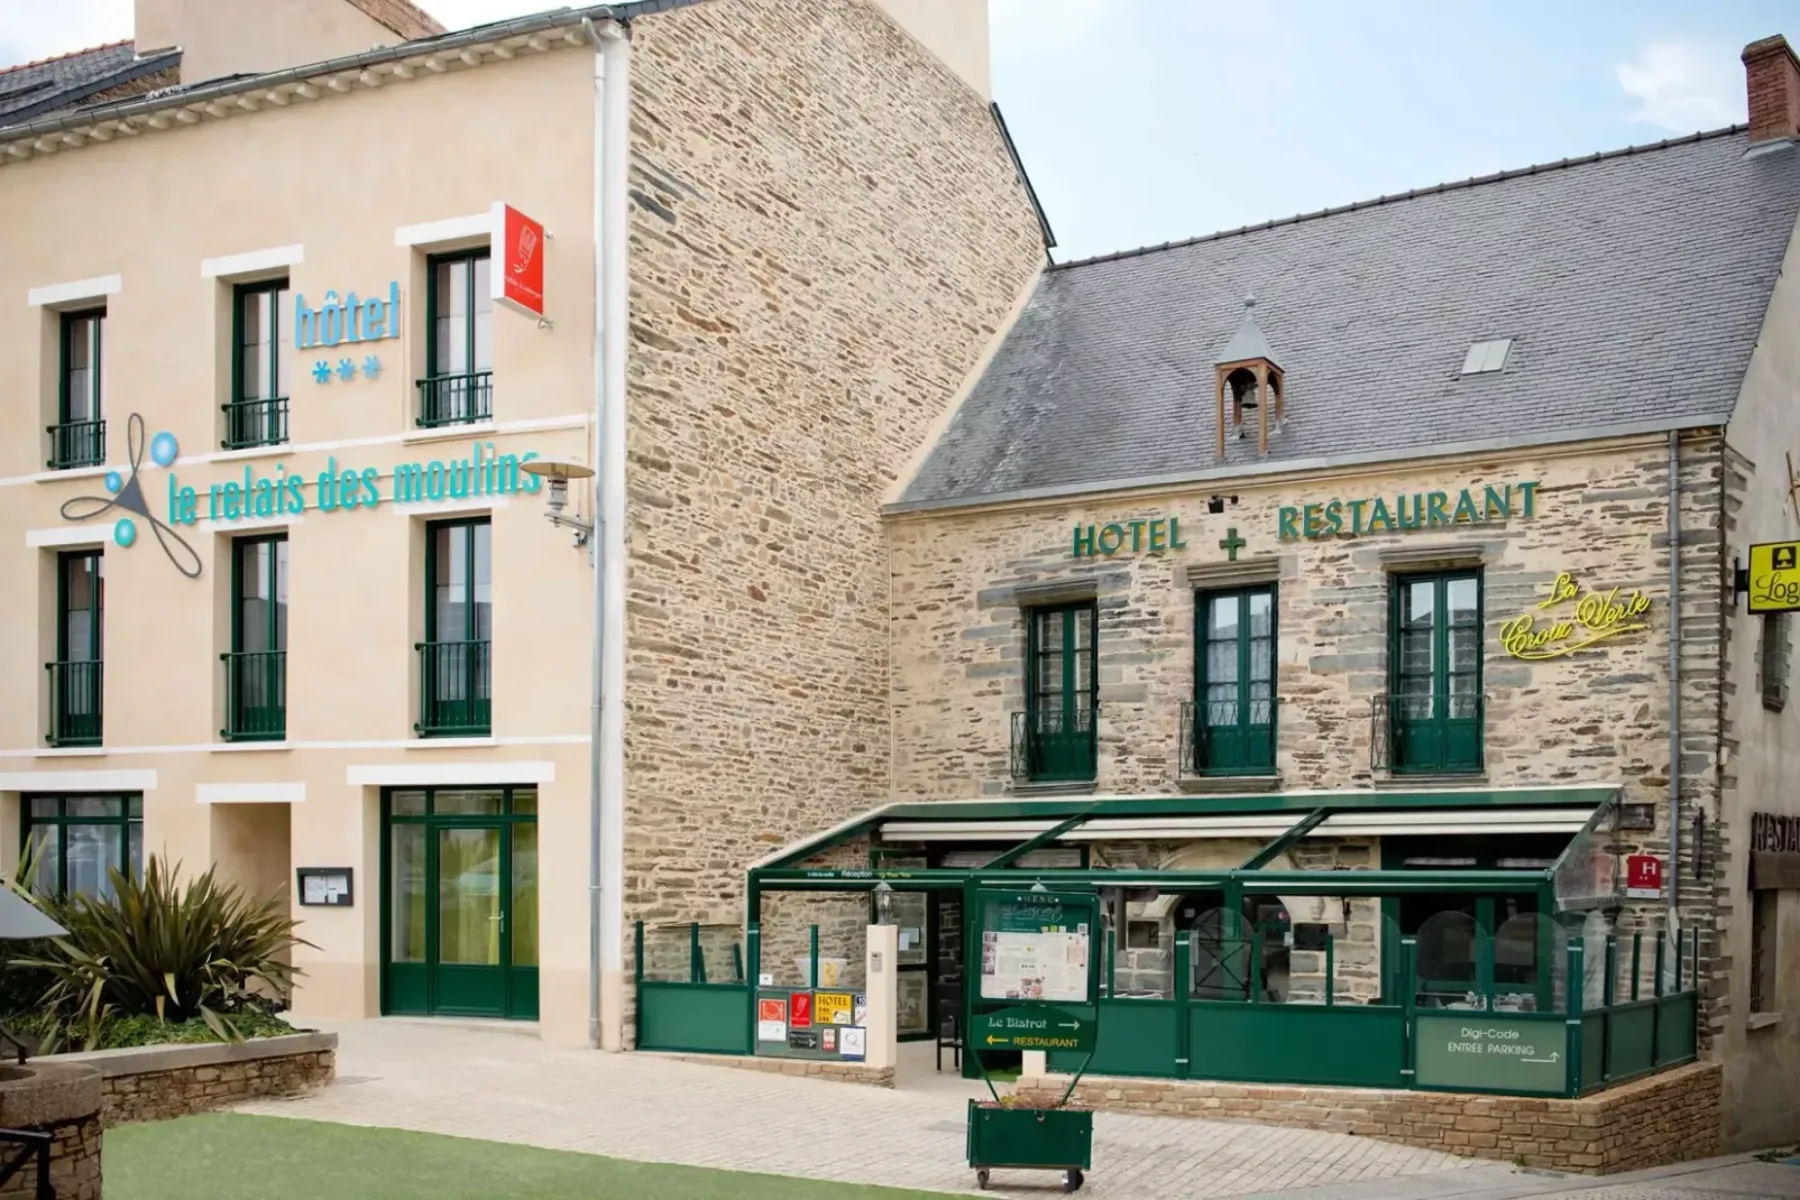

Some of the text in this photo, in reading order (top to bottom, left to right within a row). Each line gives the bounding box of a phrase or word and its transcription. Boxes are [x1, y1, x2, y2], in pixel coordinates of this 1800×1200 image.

[295, 280, 399, 350] hôtel
[169, 440, 541, 525] le relais des moulins
[1072, 479, 1541, 557] HOTEL RESTAURANT
[1537, 571, 1580, 609] La
[1499, 585, 1652, 656] Croix Verte
[1642, 862, 1657, 875] H
[818, 996, 849, 1007] HOTEL
[988, 1017, 1047, 1029] Le Bistrot
[1461, 1027, 1520, 1039] Digi-Code
[1013, 1036, 1079, 1048] RESTAURANT
[1487, 1044, 1535, 1056] PARKING
